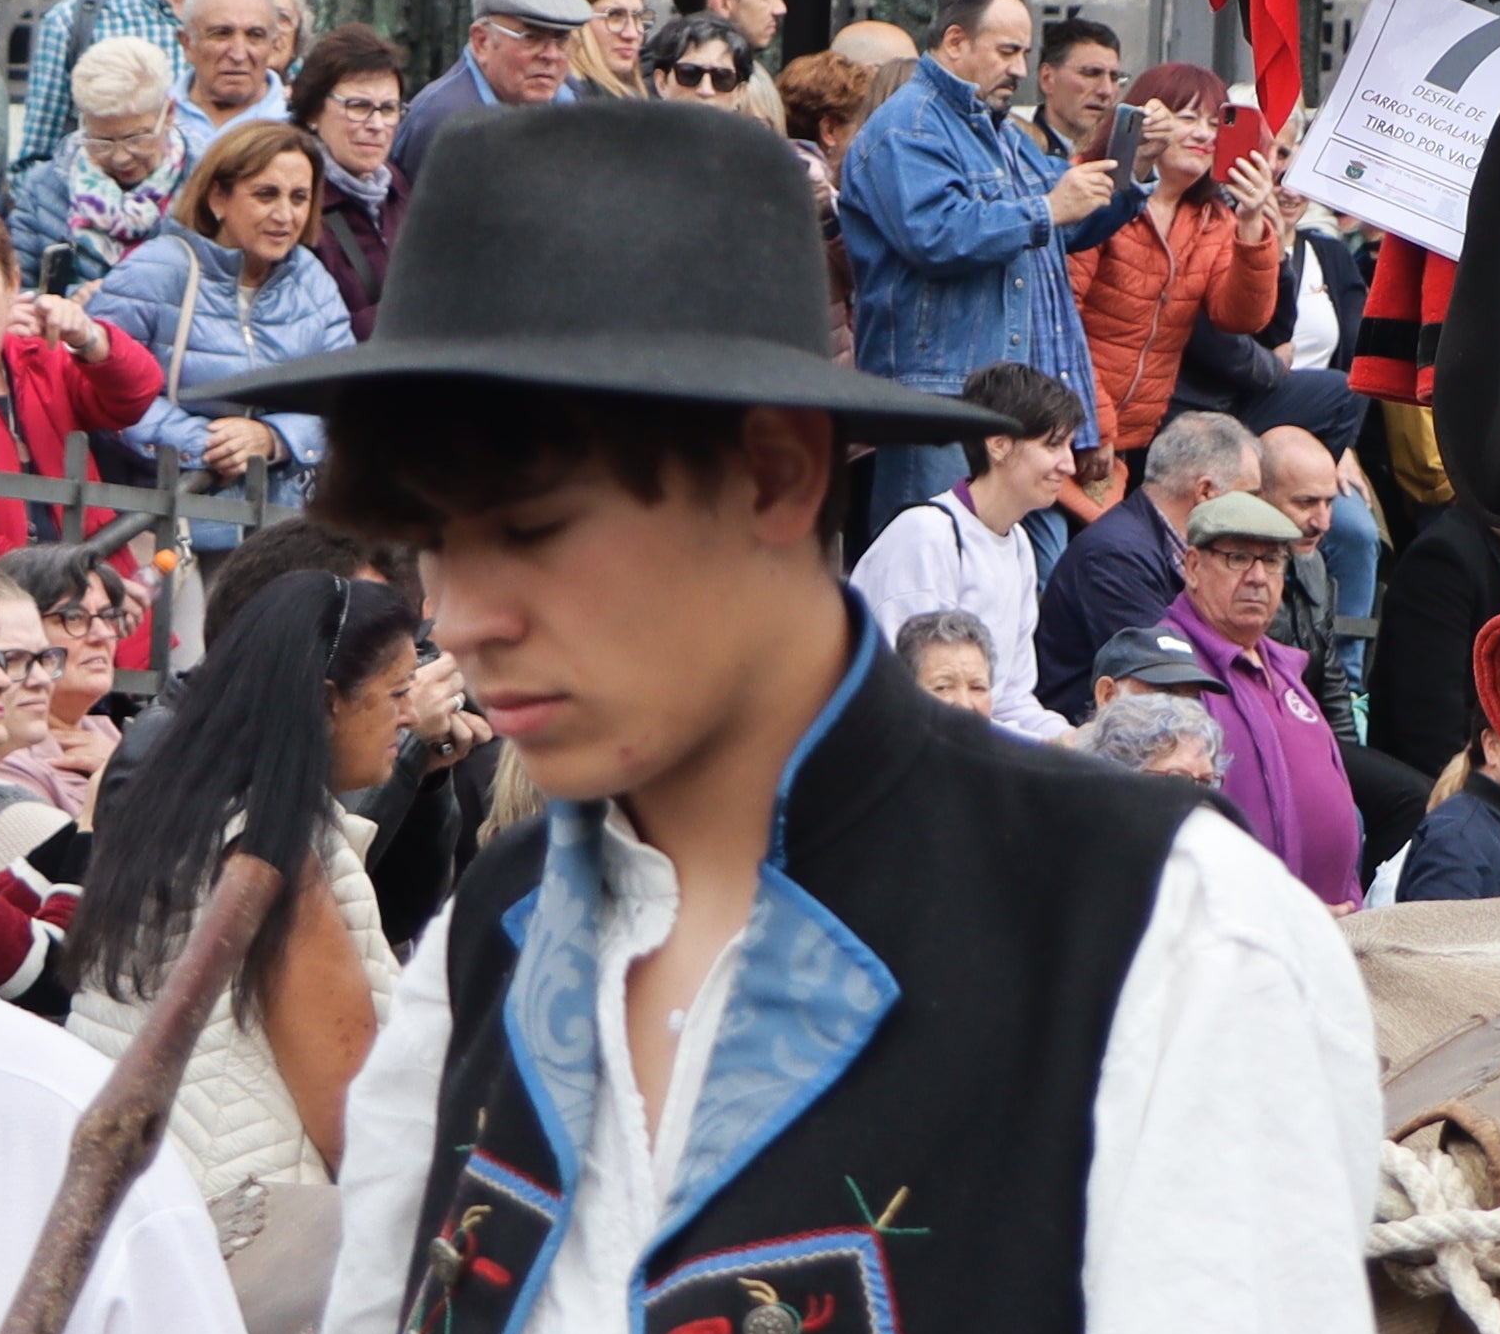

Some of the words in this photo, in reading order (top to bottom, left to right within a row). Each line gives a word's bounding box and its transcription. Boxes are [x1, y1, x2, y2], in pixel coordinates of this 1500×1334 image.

[1360, 89, 1416, 118] CARROS
[1412, 84, 1466, 114] DESFILE
[1465, 106, 1487, 122] DE
[1366, 114, 1415, 144] TIRADO
[1417, 136, 1444, 157] POR
[1448, 147, 1480, 171] VAC
